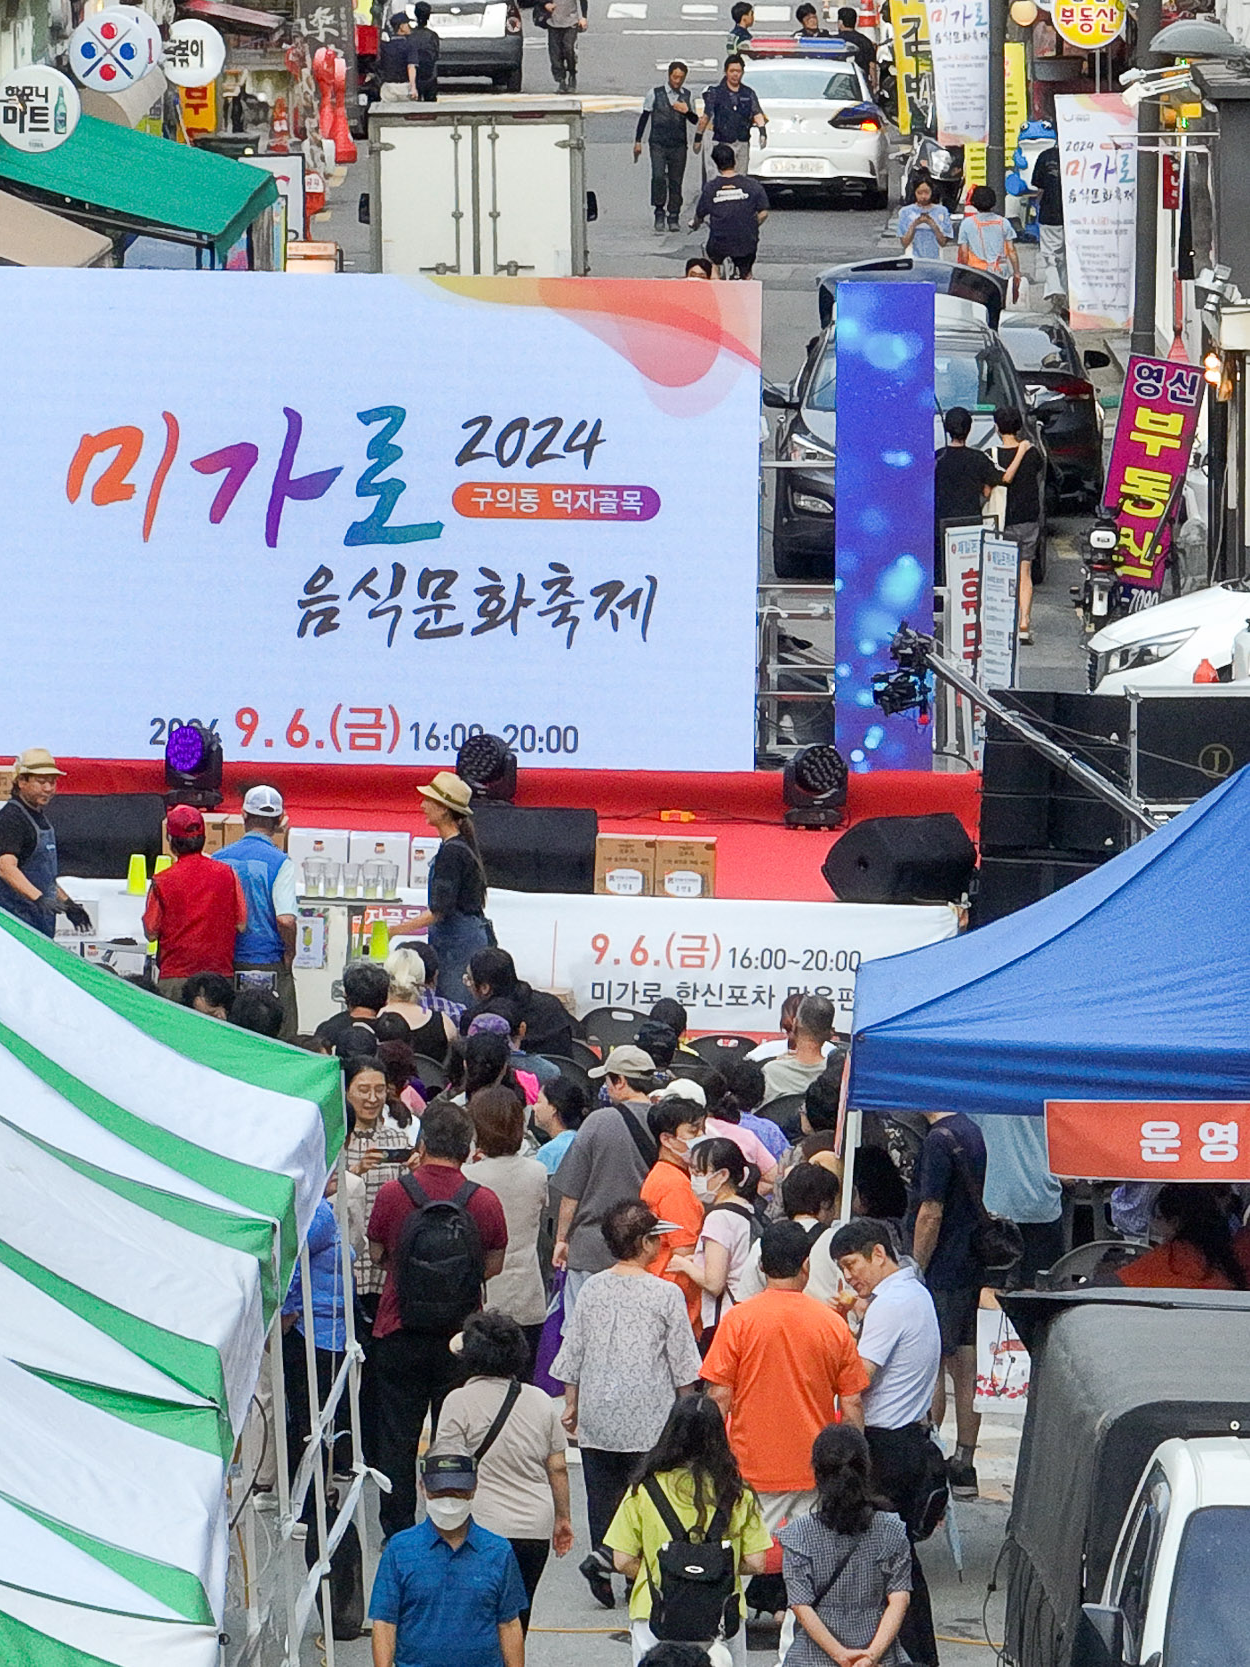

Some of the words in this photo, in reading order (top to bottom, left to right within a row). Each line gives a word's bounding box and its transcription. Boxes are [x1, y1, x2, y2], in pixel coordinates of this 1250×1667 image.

[1060, 7, 1117, 34] 부동산
[3, 106, 50, 133] 마트
[1065, 141, 1094, 152] 2024
[1065, 154, 1136, 185] 미가로
[1133, 363, 1200, 406] 영신
[455, 415, 607, 469] 2024
[66, 405, 445, 548] 미가로
[471, 487, 539, 513] 구의동
[551, 487, 645, 515] 먹자골목
[1112, 407, 1185, 581] 부동산
[297, 561, 659, 649] 음식문화축제
[727, 946, 861, 972] 16:00~20:00
[591, 980, 662, 1006] 미가로
[675, 981, 775, 1010] 한신포차
